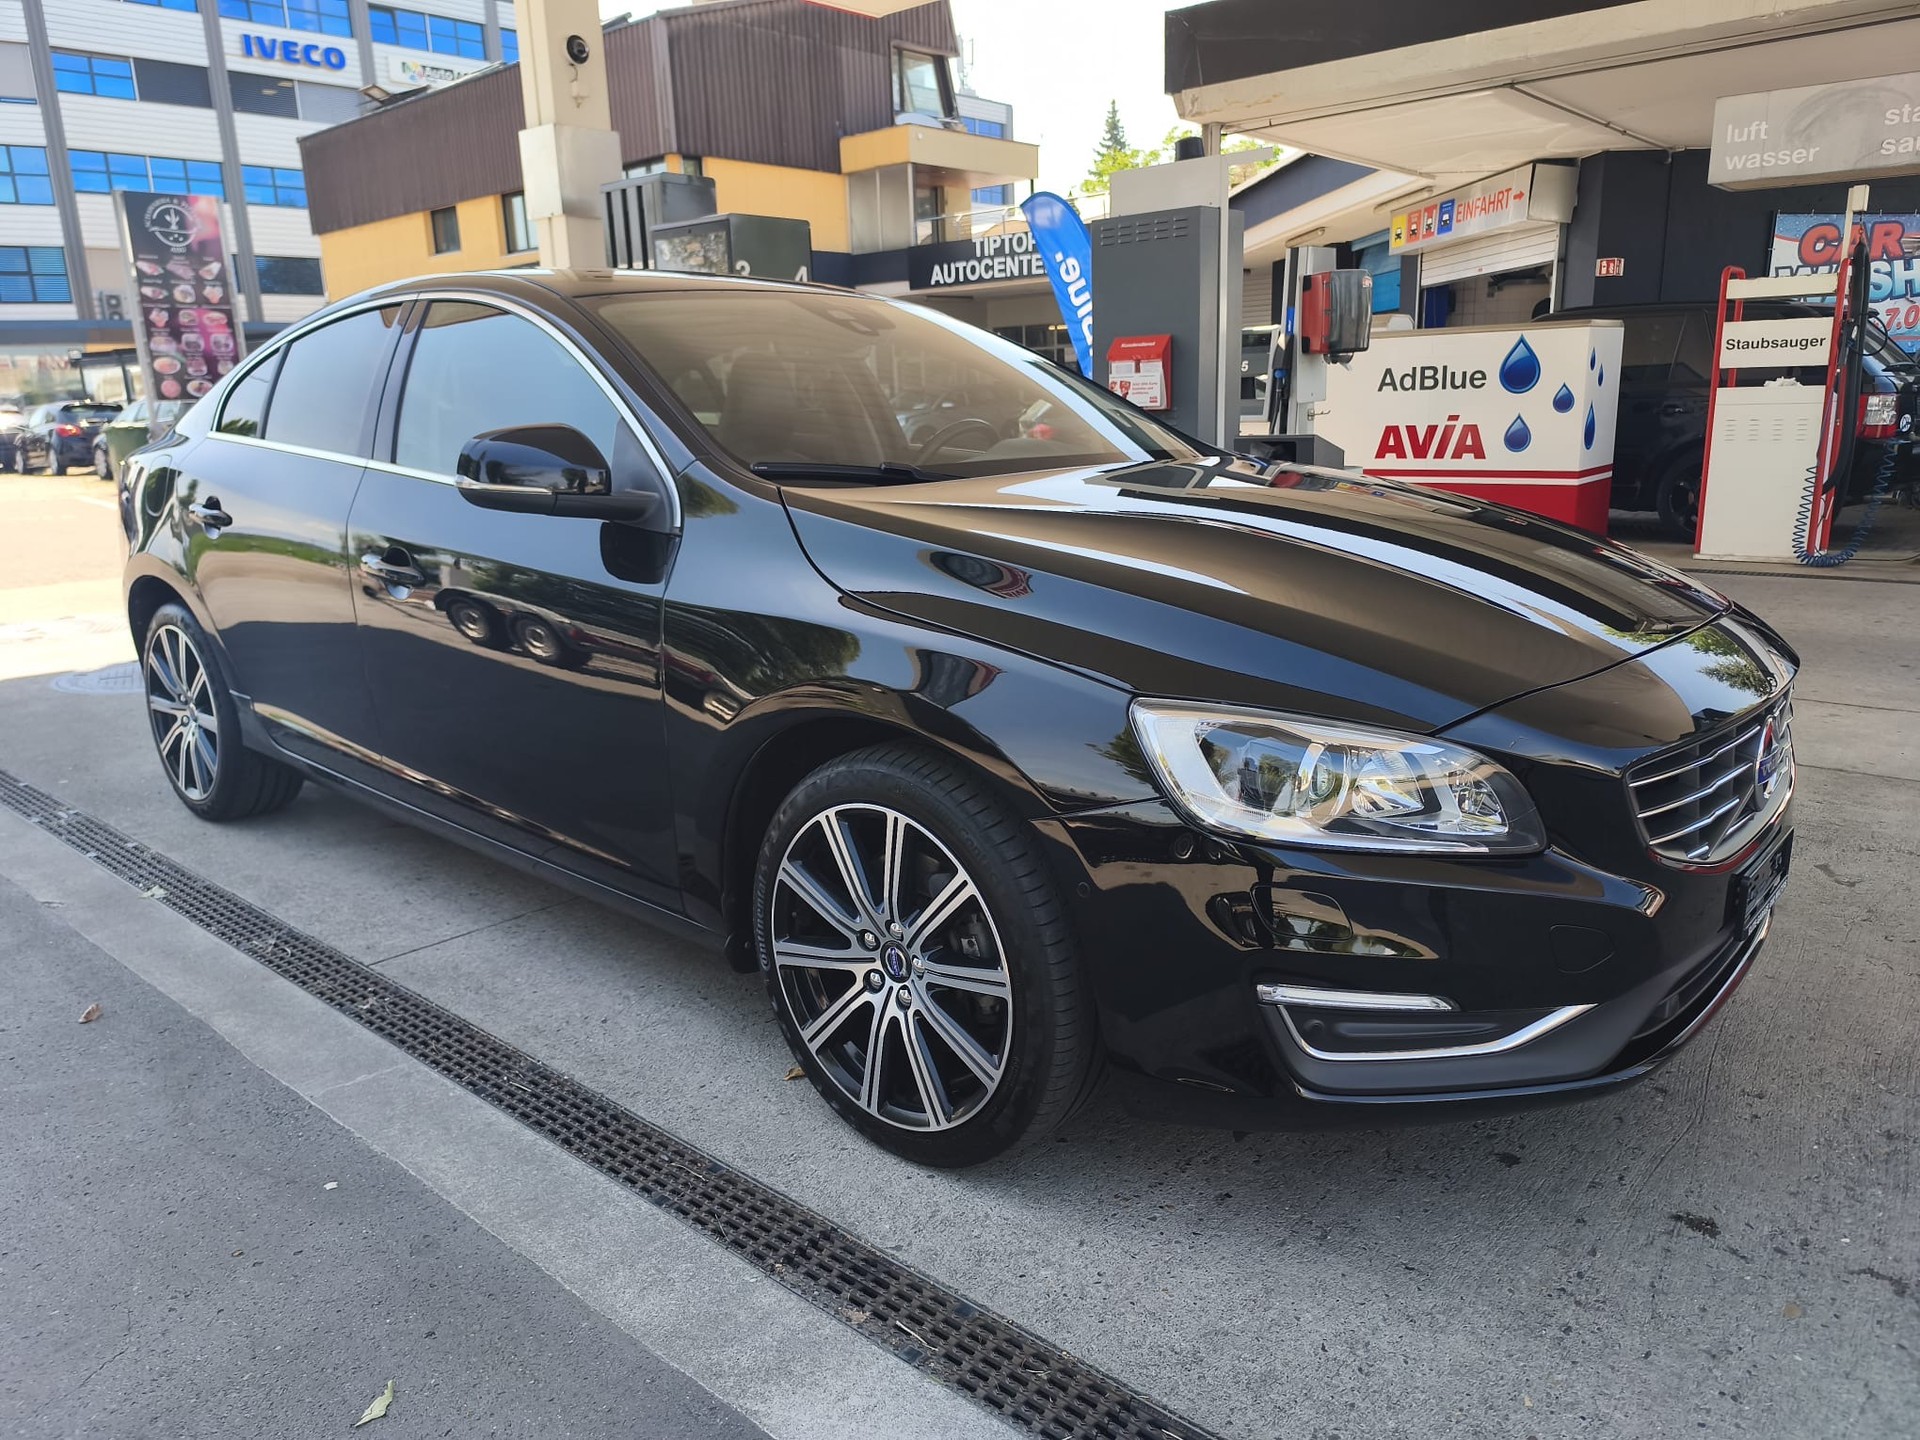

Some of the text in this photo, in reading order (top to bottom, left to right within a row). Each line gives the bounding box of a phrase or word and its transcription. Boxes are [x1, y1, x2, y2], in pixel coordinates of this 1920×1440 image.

[241, 33, 346, 71] IVECO
[1726, 121, 1768, 143] luft
[1725, 146, 1820, 170] wasser
[1455, 187, 1512, 223] EINFAHRT
[930, 254, 1047, 286] AUTOCENTE
[1725, 336, 1826, 350] Staubsauger
[1378, 365, 1487, 392] AdBlue
